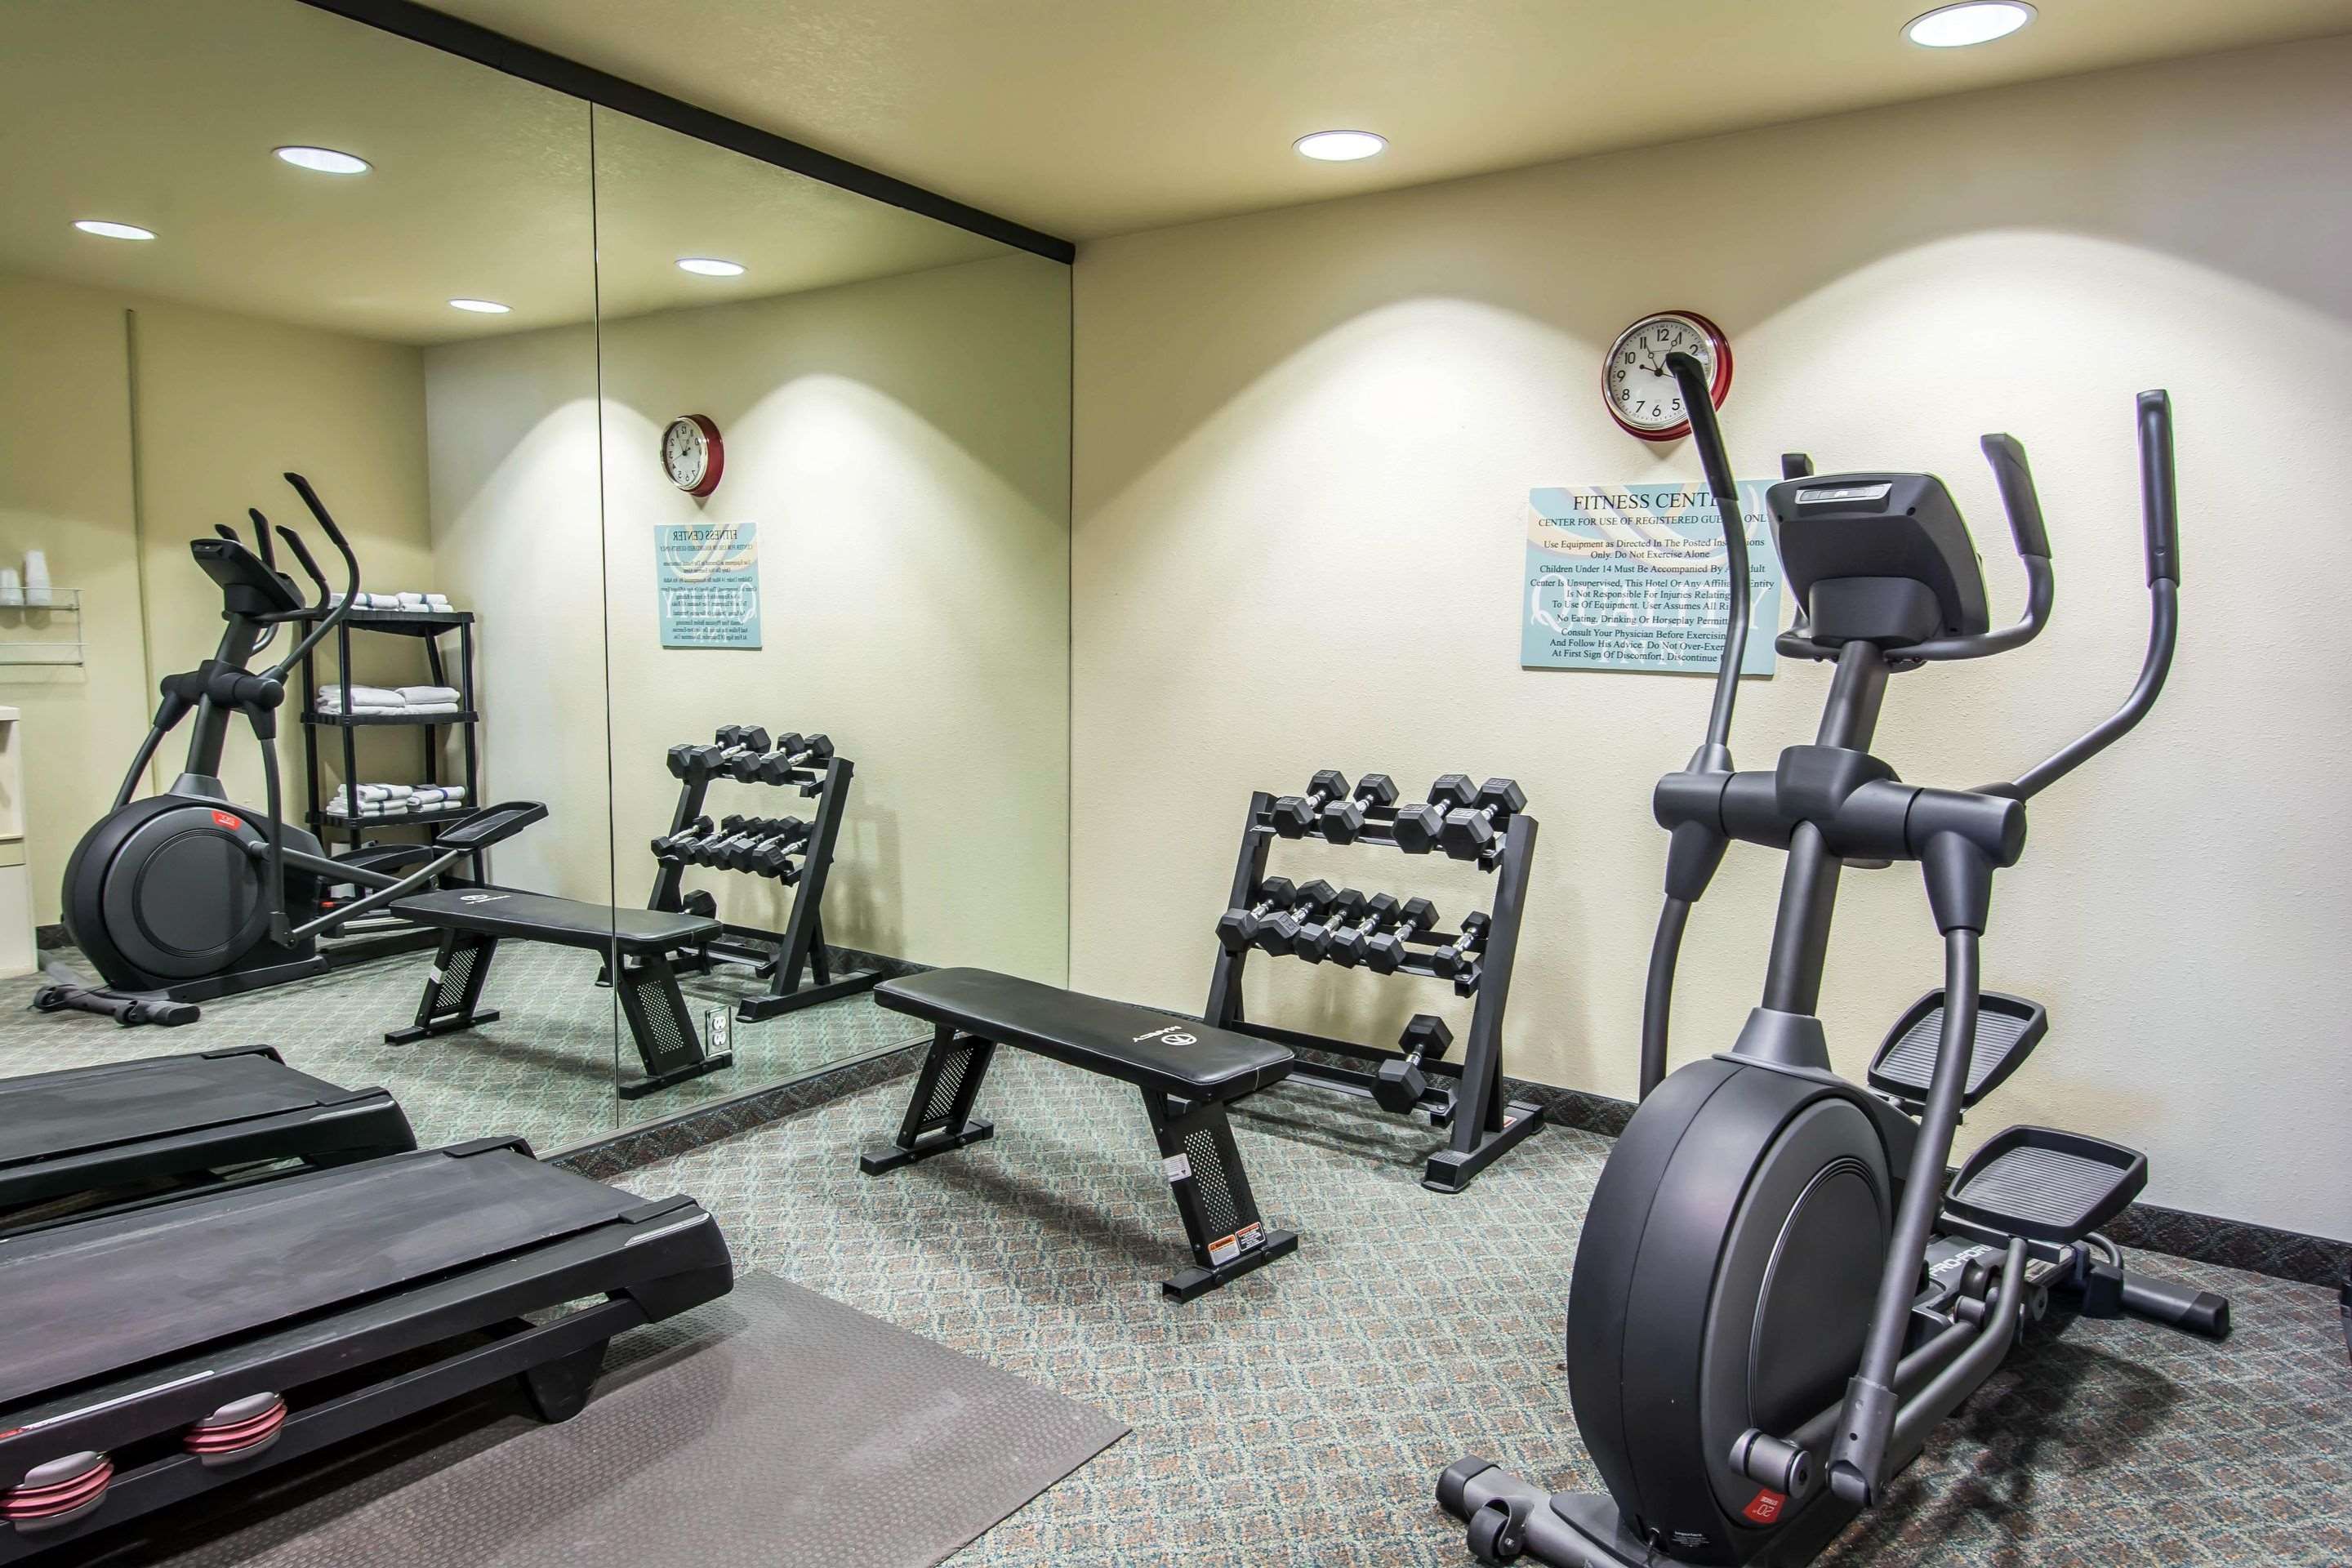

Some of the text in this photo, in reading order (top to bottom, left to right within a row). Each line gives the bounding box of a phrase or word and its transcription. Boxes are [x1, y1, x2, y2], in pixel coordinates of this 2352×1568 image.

[1656, 328, 1669, 341] 12
[1640, 336, 1647, 350] 11
[1690, 344, 1699, 356] 2
[1624, 351, 1636, 364] 10
[1617, 370, 1626, 382] 9
[1622, 389, 1630, 401] 8
[1636, 400, 1645, 412] 7
[1652, 404, 1661, 416] 6
[1672, 399, 1680, 411] 5
[1573, 492, 1717, 510] FITNESS CENT
[1539, 514, 1766, 527] CENTER FOR USE OF REGISTERED GUE ONL
[1561, 541, 1603, 550] Equipment
[1616, 539, 1650, 548] Directed
[1653, 539, 1662, 547] In
[1664, 539, 1681, 547] The
[1683, 538, 1711, 546] Posted
[1647, 550, 1682, 559] Exercise
[1539, 564, 1573, 573] Children
[1575, 564, 1600, 572] Under
[1650, 565, 1708, 575] Accompanied
[1711, 564, 1723, 573] By
[1530, 579, 1556, 587] Center
[1567, 579, 1623, 589] Unsupervised,
[1625, 579, 1643, 587] This
[1683, 580, 1701, 589] Any
[1704, 580, 1731, 588] Affilia
[1593, 590, 1642, 600] Responsible
[1660, 590, 1692, 600] Injuries
[1695, 591, 1731, 600] Relating
[1552, 600, 1562, 608] To
[1564, 600, 1579, 608] Use
[1581, 600, 1593, 608] Of
[1642, 601, 1662, 609] User
[1664, 602, 1700, 610] Assumes
[1557, 614, 1569, 622] No
[1601, 615, 1637, 625] Drinking
[1652, 617, 1695, 626] Horseplay
[1697, 617, 1729, 626] Permitt
[1561, 627, 1726, 639] Consult Your Physician Before Exercisin
[1550, 639, 1566, 647] And
[1568, 639, 1595, 648] Follow
[1598, 639, 1612, 648] His
[1647, 641, 1659, 649] Do
[1663, 641, 1678, 649] Not
[1680, 642, 1725, 651] Over-Exer
[1563, 649, 1582, 657] First
[1584, 650, 1601, 660] Sign
[1603, 651, 1616, 659] Of
[1667, 653, 1717, 662] Discontinue
